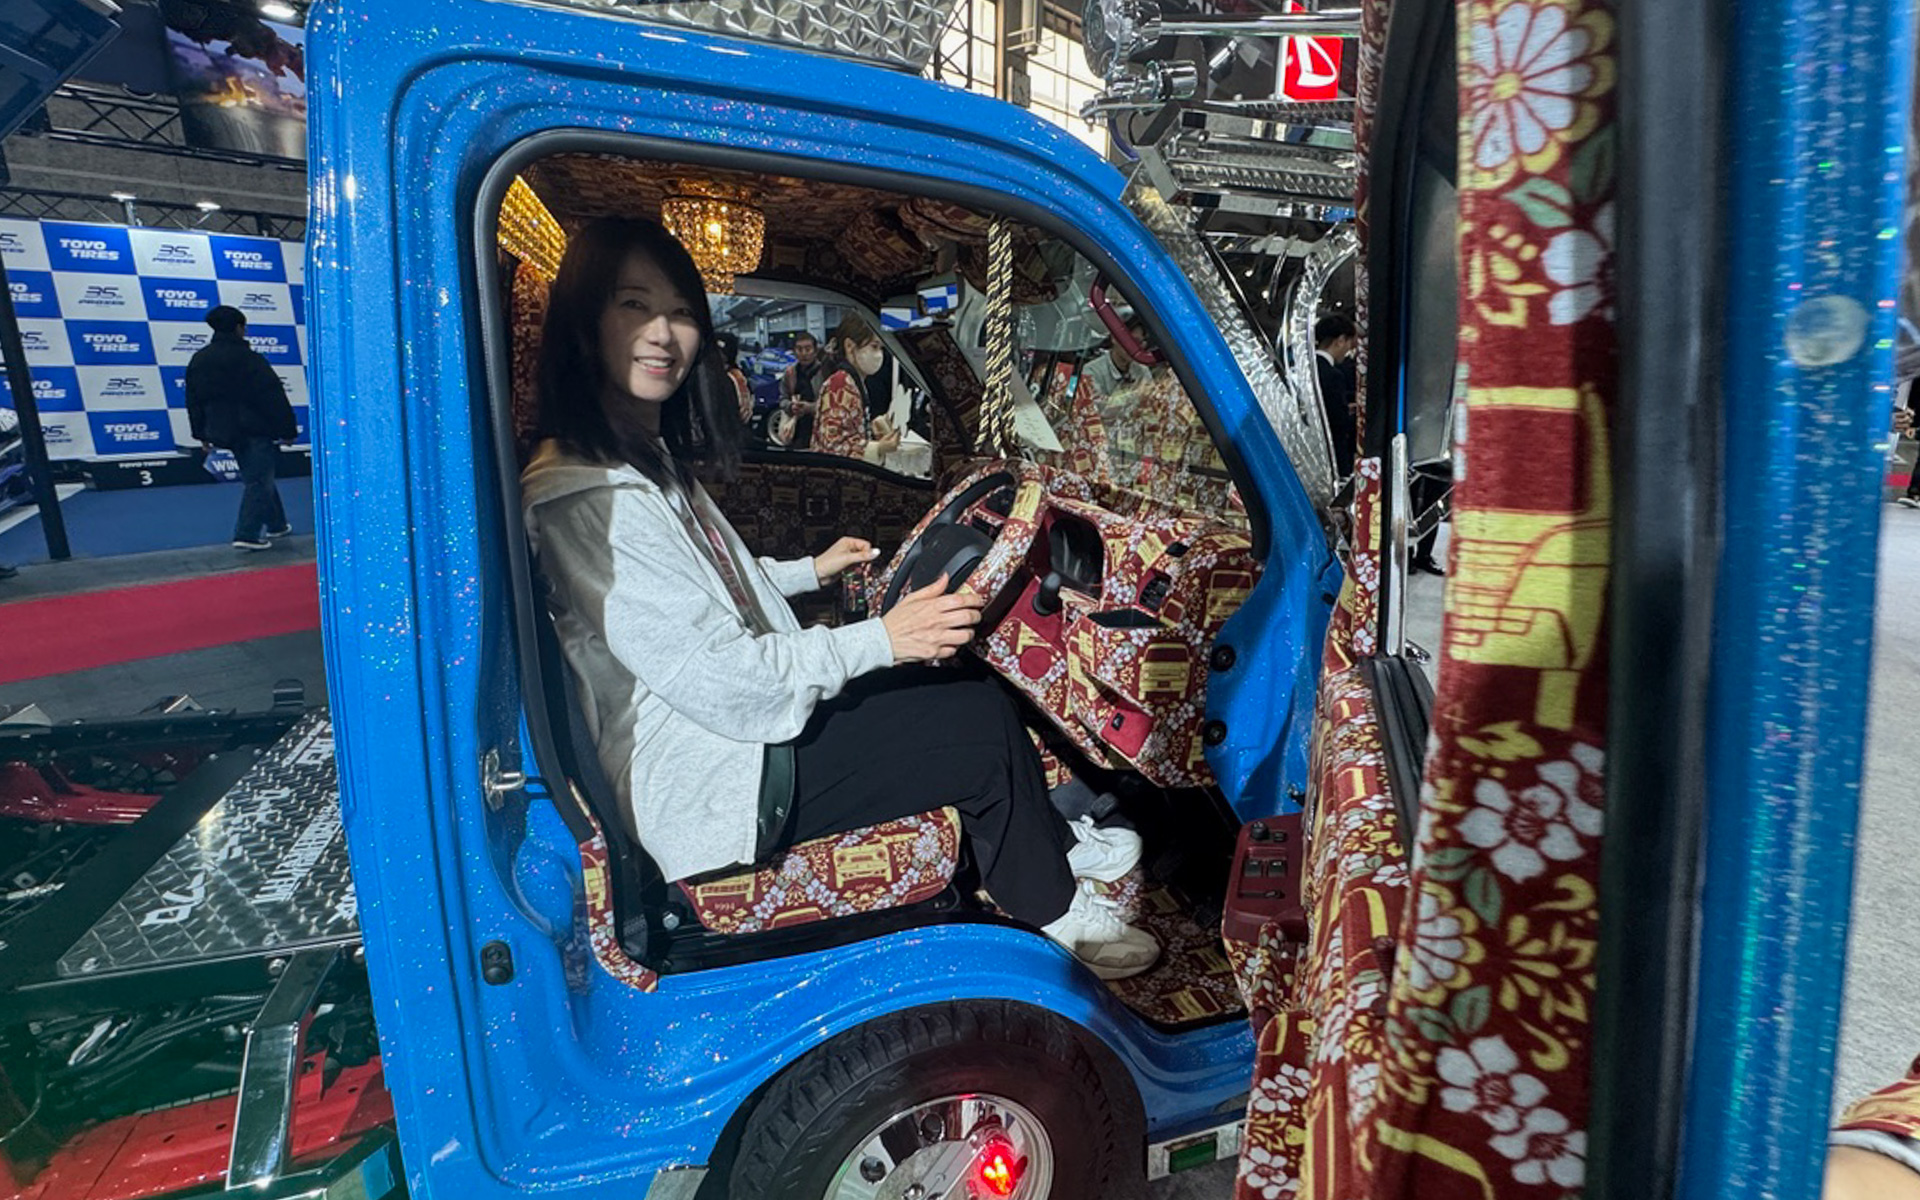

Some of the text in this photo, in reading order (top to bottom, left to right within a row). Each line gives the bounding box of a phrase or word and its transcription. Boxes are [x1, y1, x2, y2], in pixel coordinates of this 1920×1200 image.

[59, 238, 106, 249] TOYO
[70, 248, 119, 261] TIRES
[223, 250, 262, 261] TOYO
[231, 260, 273, 270] TIRES
[155, 289, 197, 299] TOYO
[164, 299, 209, 308] TIRES
[83, 333, 128, 343] TOYO
[92, 342, 140, 353] TIRES
[104, 423, 147, 433] TOYO
[114, 431, 160, 442] TIRES
[139, 470, 153, 486] 3
